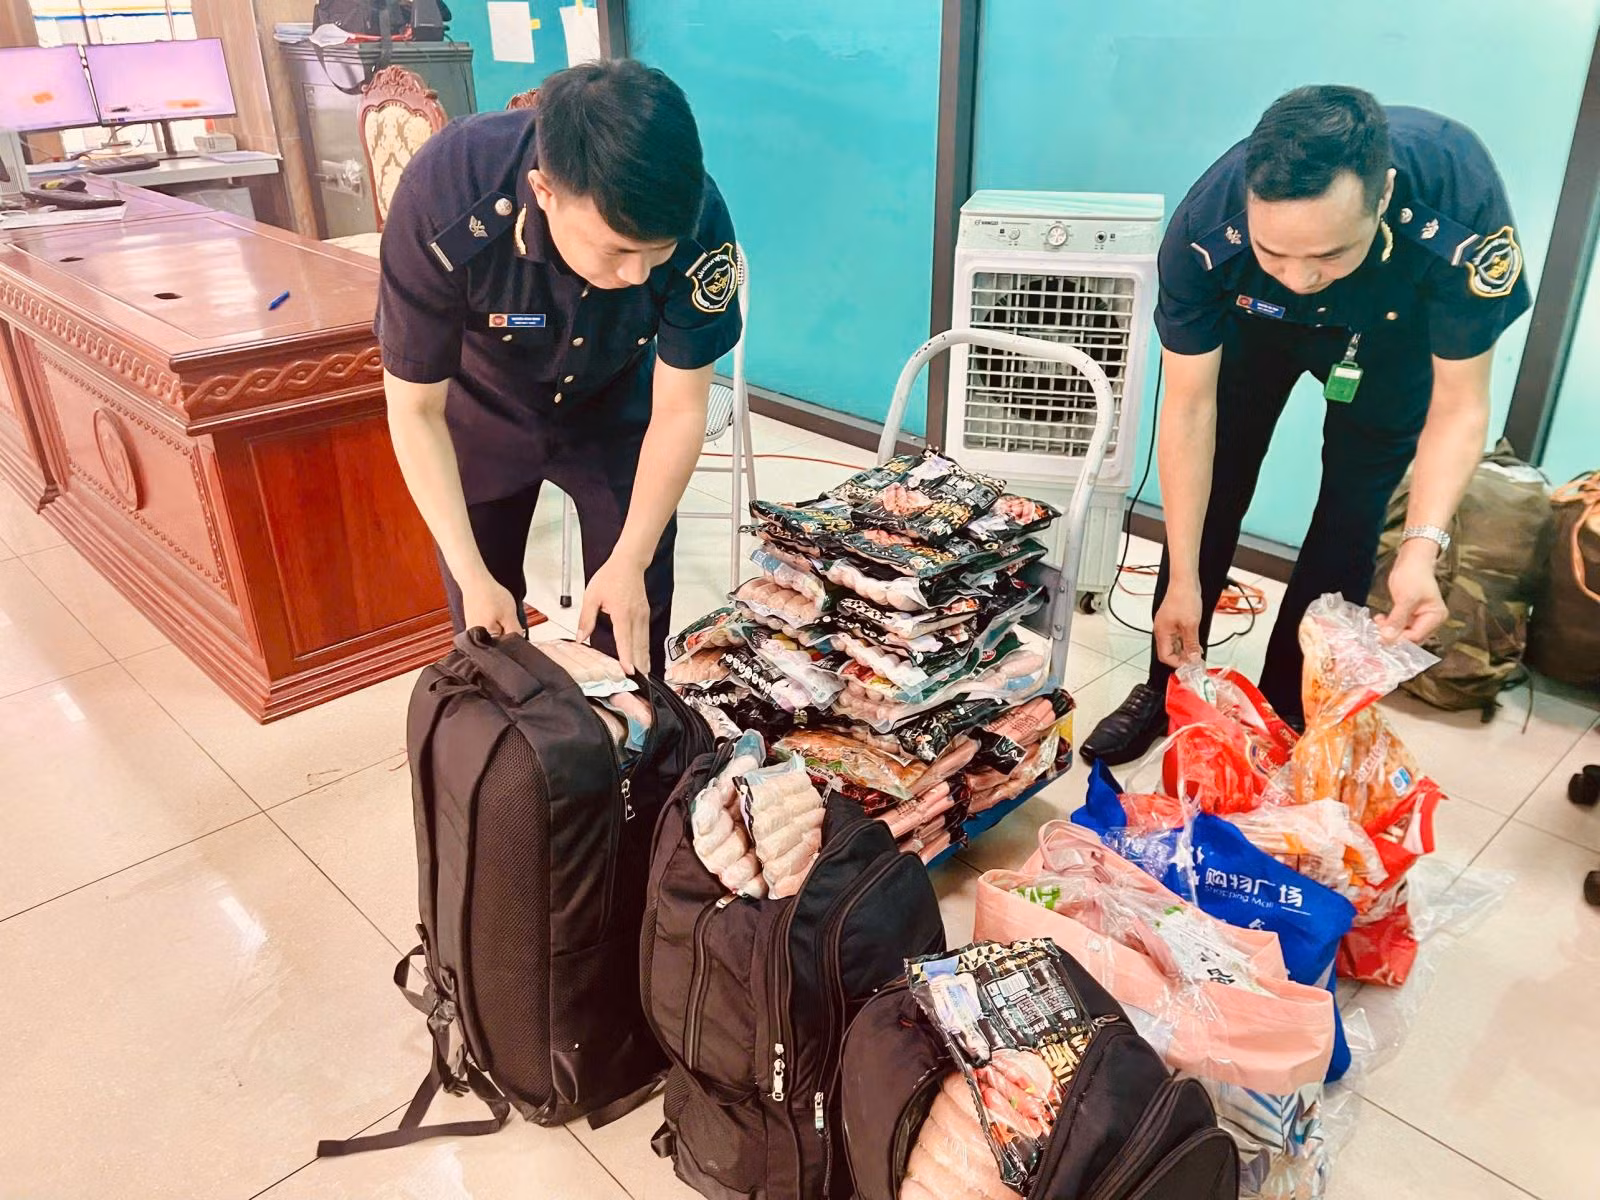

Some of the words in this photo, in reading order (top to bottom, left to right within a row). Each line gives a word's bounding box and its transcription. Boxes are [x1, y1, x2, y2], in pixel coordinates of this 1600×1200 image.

[1204, 885, 1250, 903] Shopping
[1251, 897, 1274, 909] Mall
[1205, 867, 1303, 907] 购物广场
